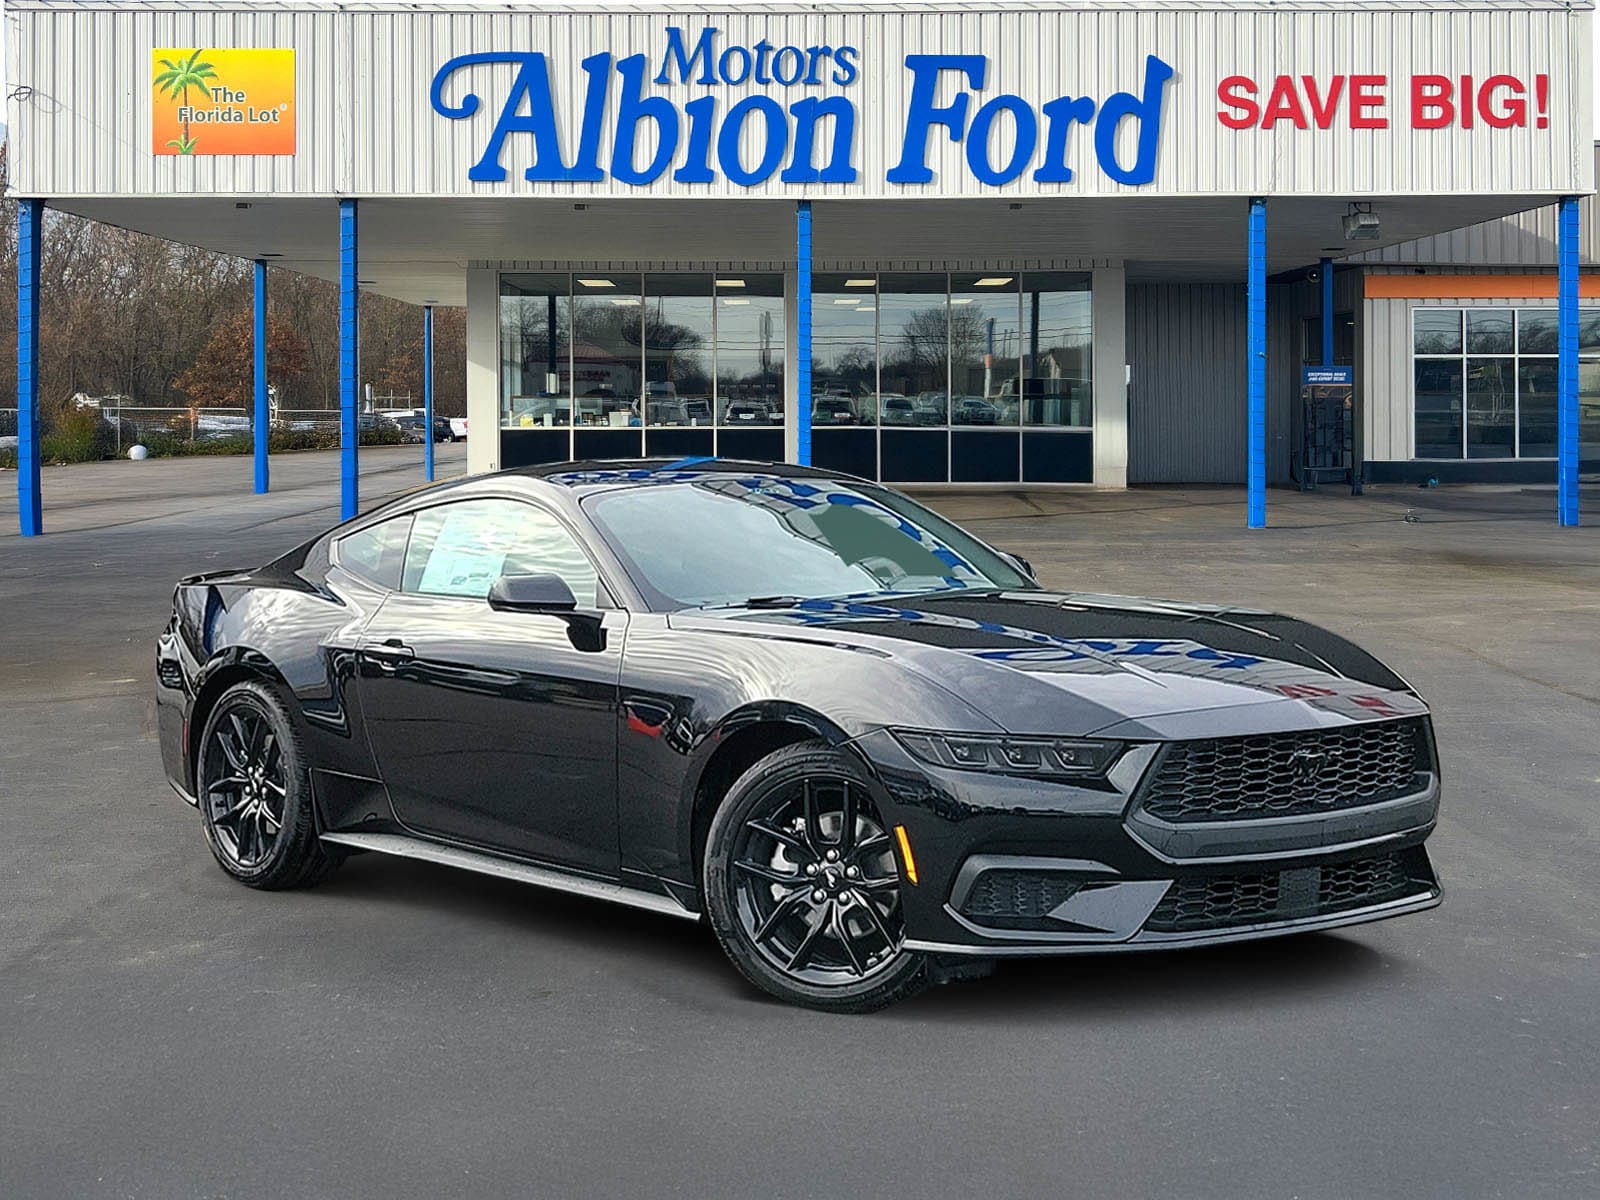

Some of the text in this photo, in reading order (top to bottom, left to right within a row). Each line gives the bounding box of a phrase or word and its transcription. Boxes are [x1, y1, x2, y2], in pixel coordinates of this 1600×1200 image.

[655, 27, 857, 86] Motors
[178, 106, 279, 122] Florida Lot
[211, 86, 245, 103] The
[430, 52, 1174, 186] Albion Ford
[1217, 74, 1548, 129] SAVE BIG!
